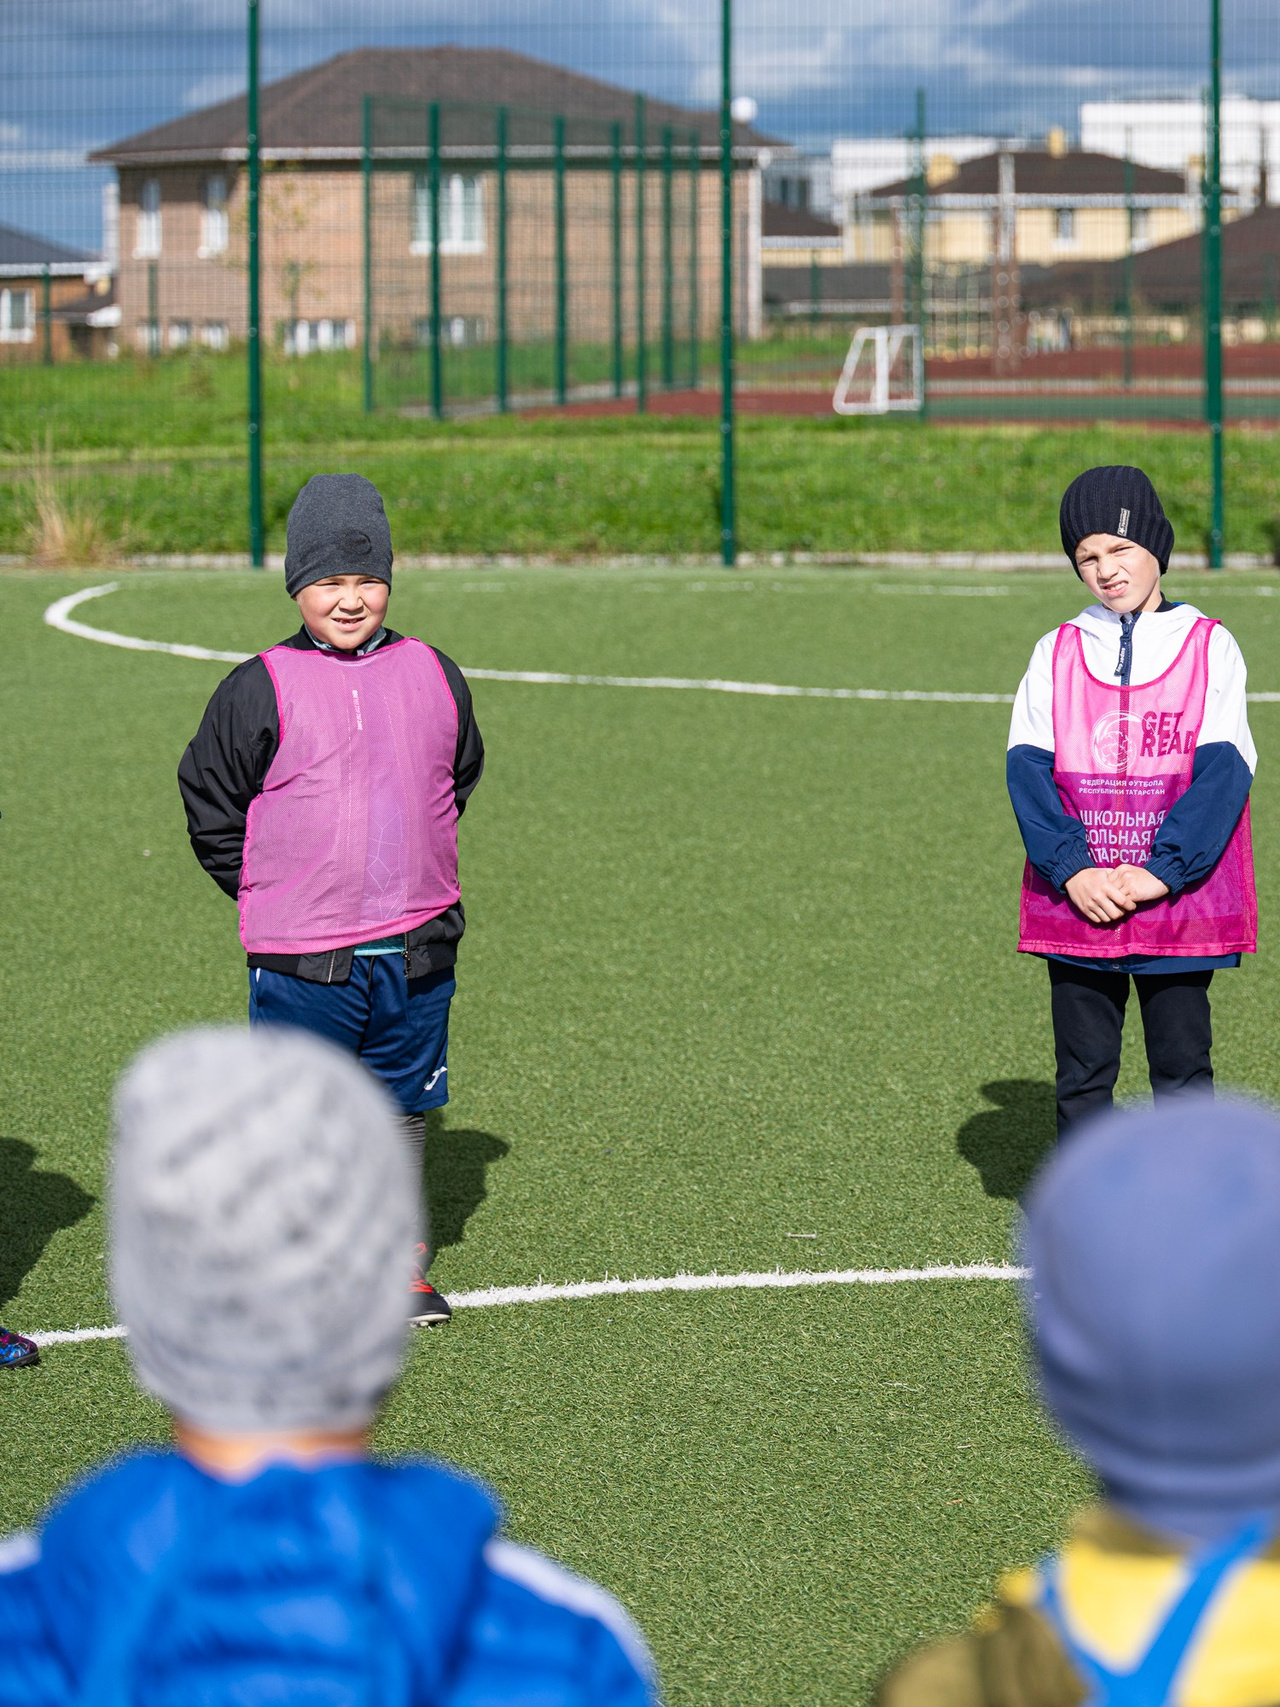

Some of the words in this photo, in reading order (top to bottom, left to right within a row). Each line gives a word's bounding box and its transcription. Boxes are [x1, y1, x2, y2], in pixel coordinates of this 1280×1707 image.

[1141, 711, 1184, 735] GET
[1128, 780, 1164, 788] ФУТБОЛА
[1080, 810, 1166, 827] ШКОЛЬНАЯ
[1086, 828, 1152, 847] ОЛЬНАЯ
